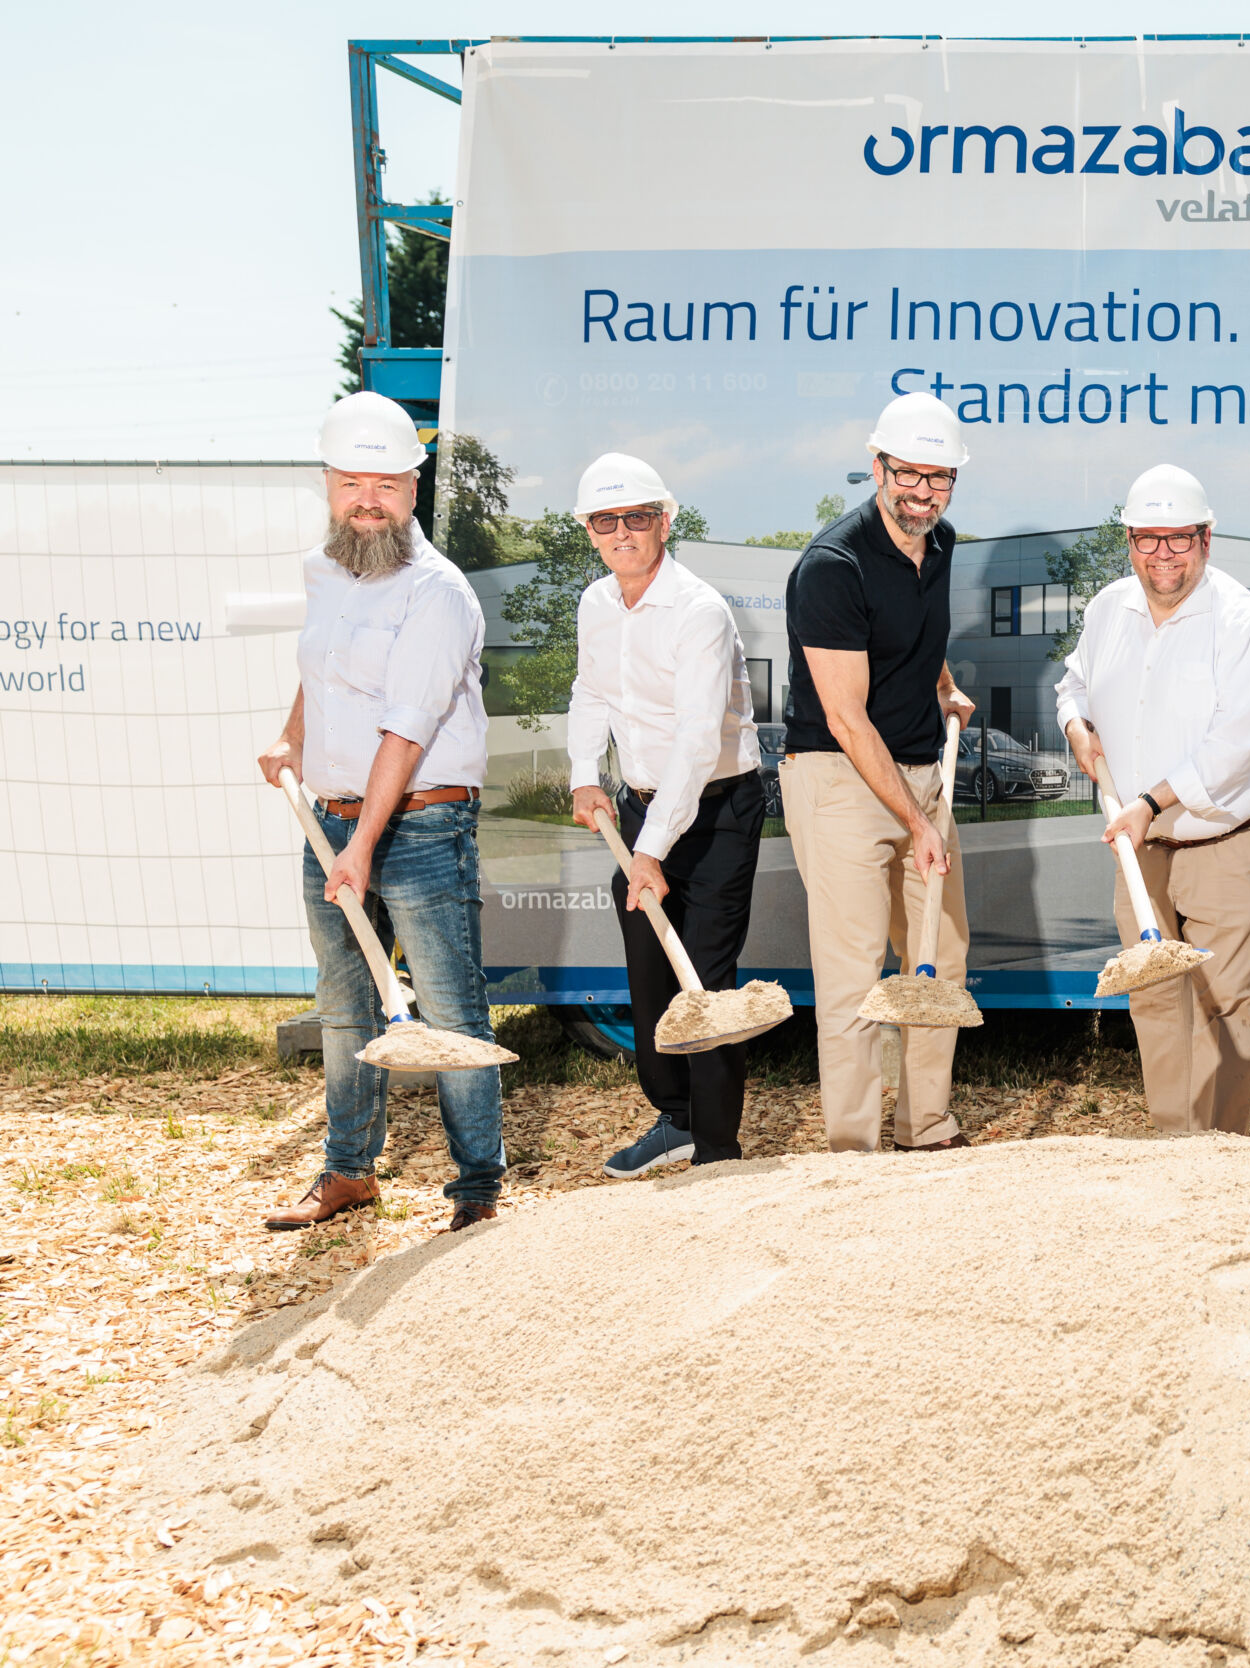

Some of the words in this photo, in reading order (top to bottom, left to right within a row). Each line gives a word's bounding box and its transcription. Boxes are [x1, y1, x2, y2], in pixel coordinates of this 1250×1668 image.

[583, 289, 757, 344] Raum
[779, 284, 869, 342] für
[890, 287, 1238, 343] Innovation.
[890, 367, 1169, 425] Standort
[57, 612, 100, 641] for
[111, 620, 128, 642] a
[137, 621, 201, 642] new
[0, 663, 85, 692] world
[501, 886, 617, 910] ormazab
